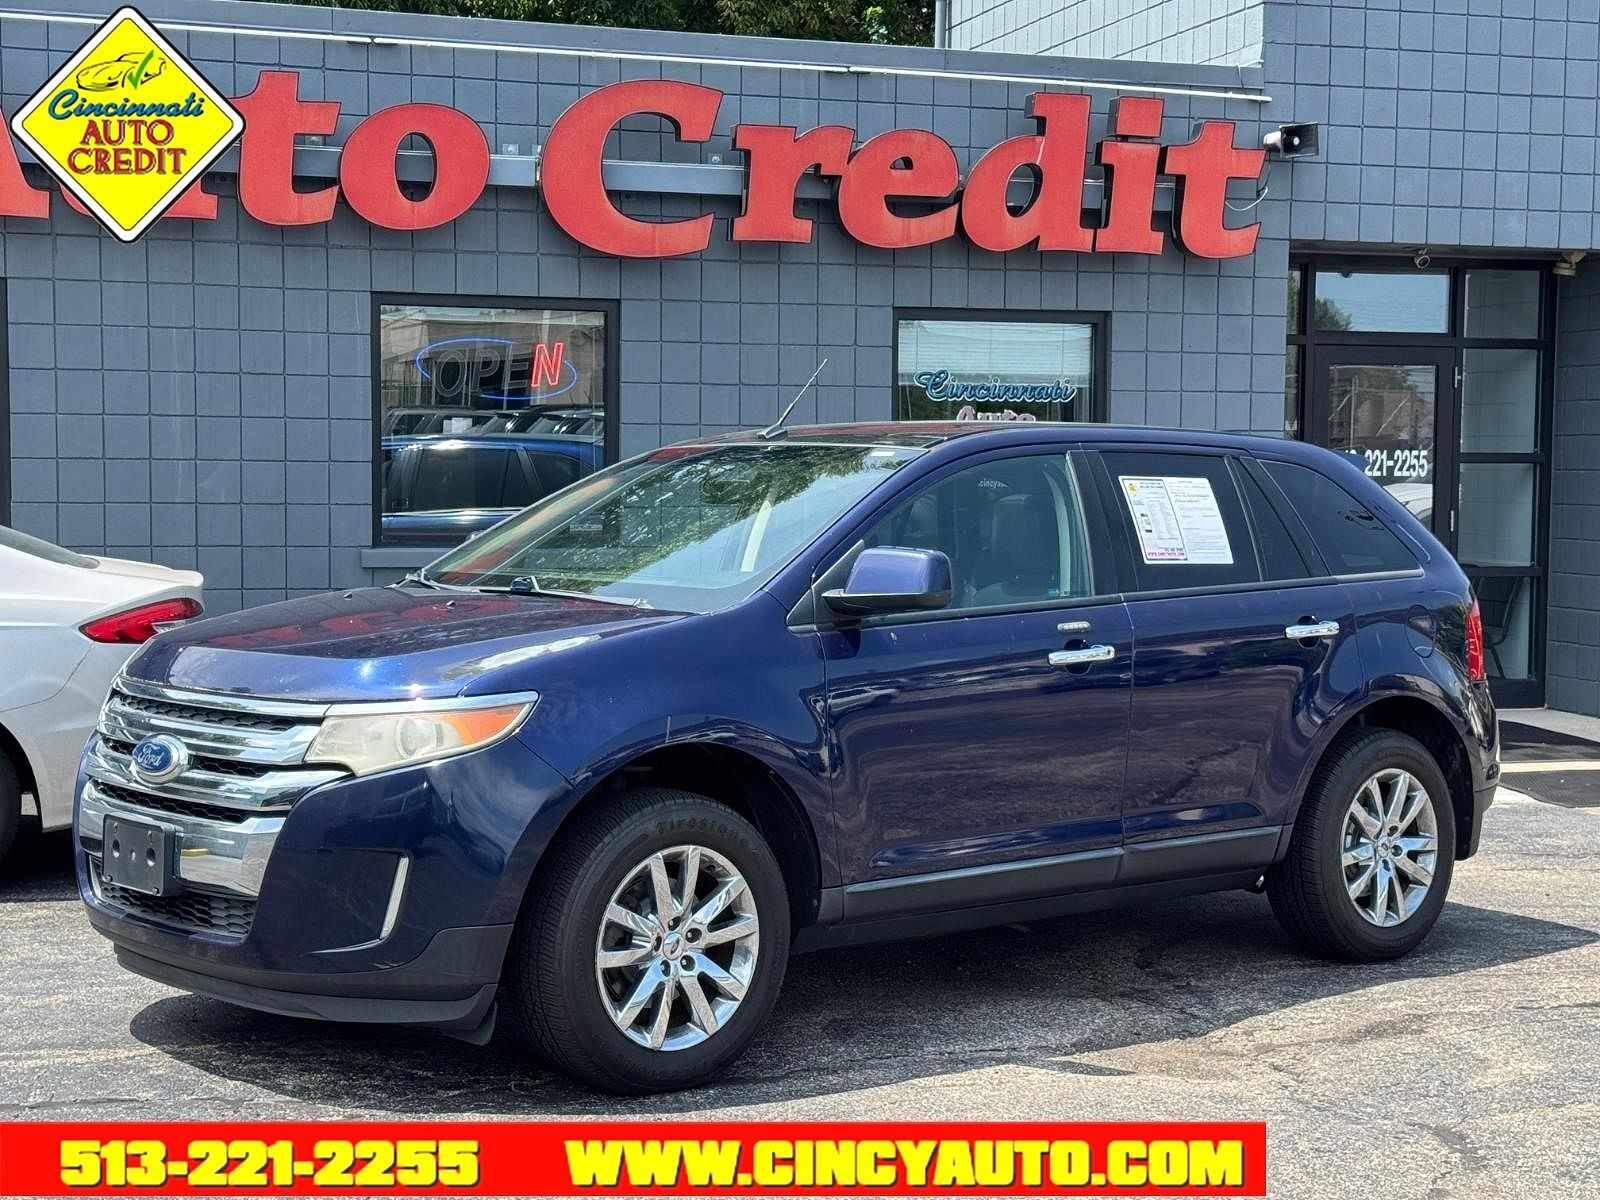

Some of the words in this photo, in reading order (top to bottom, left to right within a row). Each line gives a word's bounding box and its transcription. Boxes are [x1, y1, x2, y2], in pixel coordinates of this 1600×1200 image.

[539, 80, 1267, 259] Credit
[434, 342, 565, 397] OPEN
[914, 368, 1078, 402] Cincinnati
[134, 743, 165, 769] Ford
